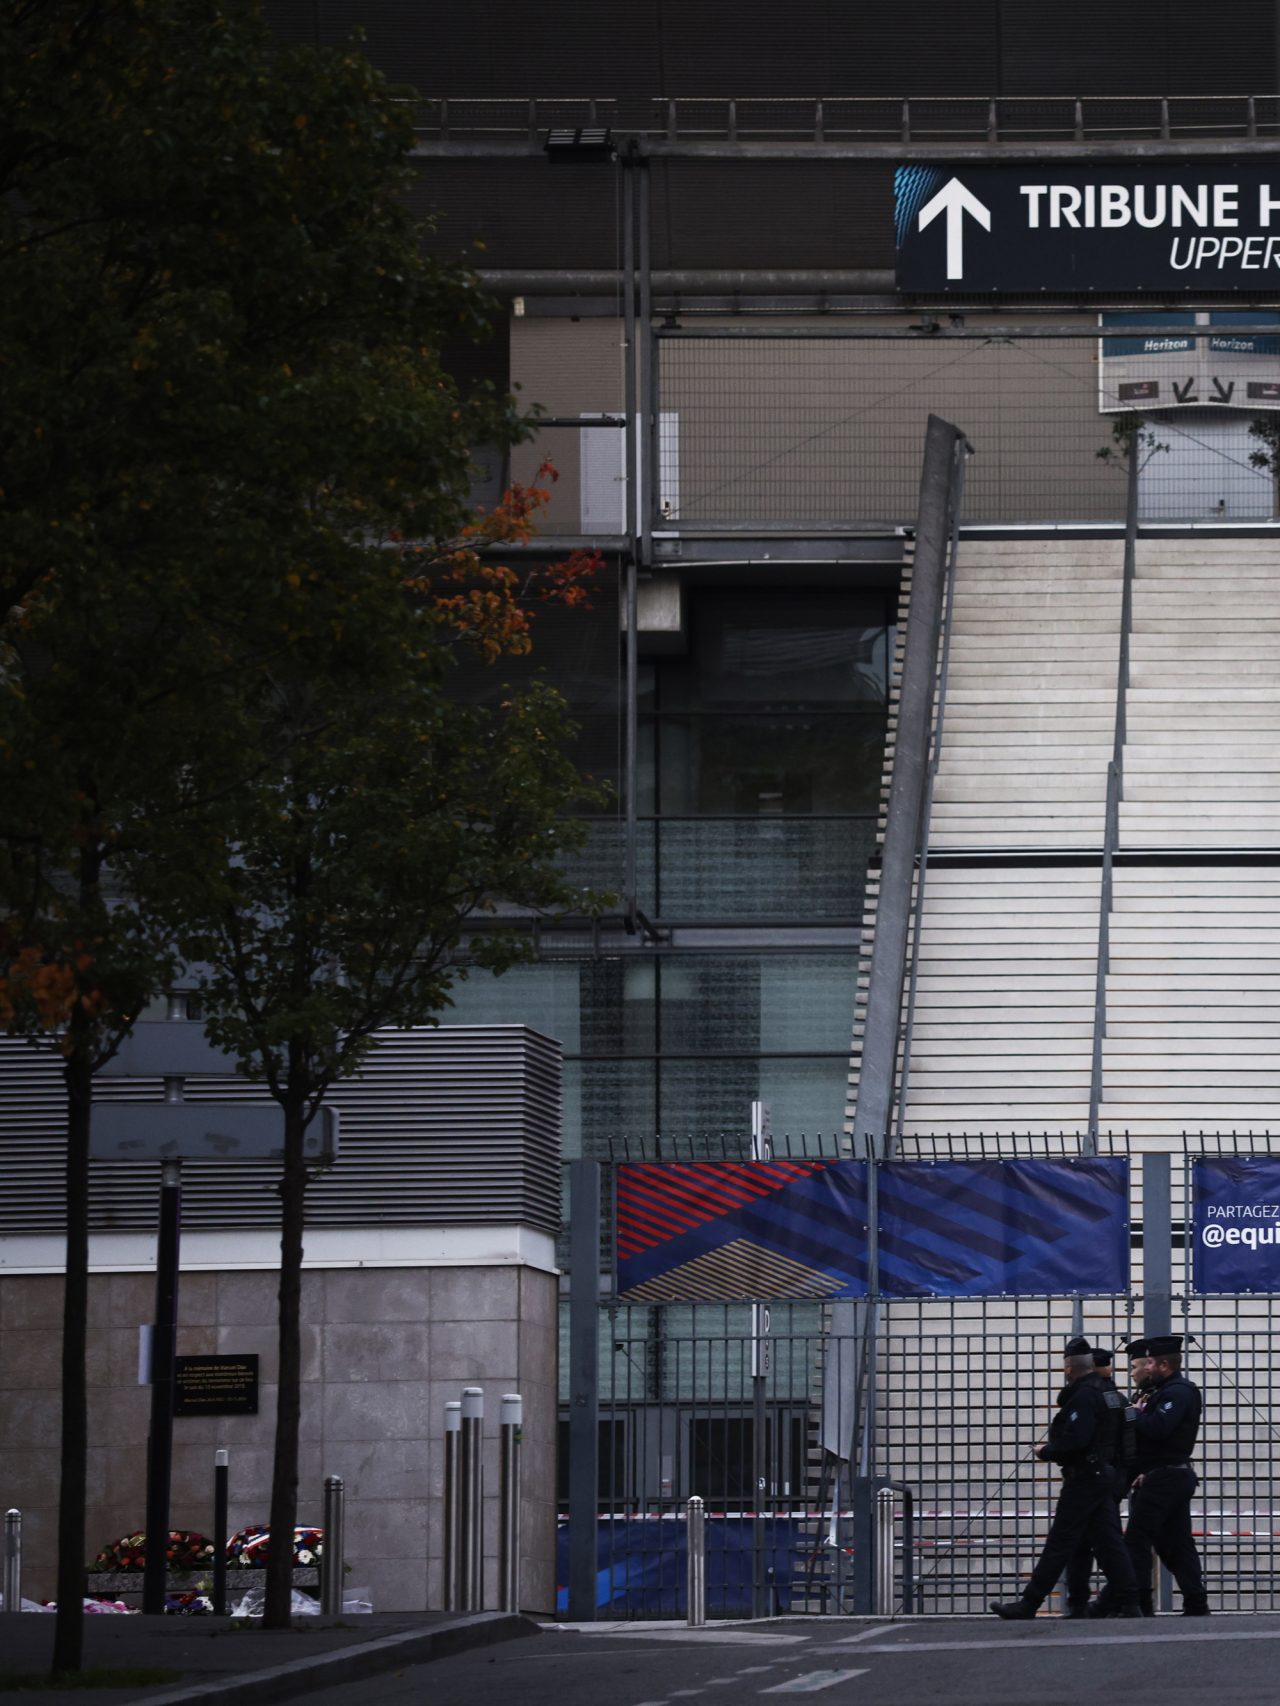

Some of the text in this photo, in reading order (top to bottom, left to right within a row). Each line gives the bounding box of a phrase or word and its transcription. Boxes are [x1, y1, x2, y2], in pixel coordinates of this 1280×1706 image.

[1019, 184, 1239, 229] TRIBUNE
[1144, 338, 1188, 351] Horizon
[1212, 337, 1255, 351] Horizon
[1207, 1204, 1280, 1218] PARTAGEZ
